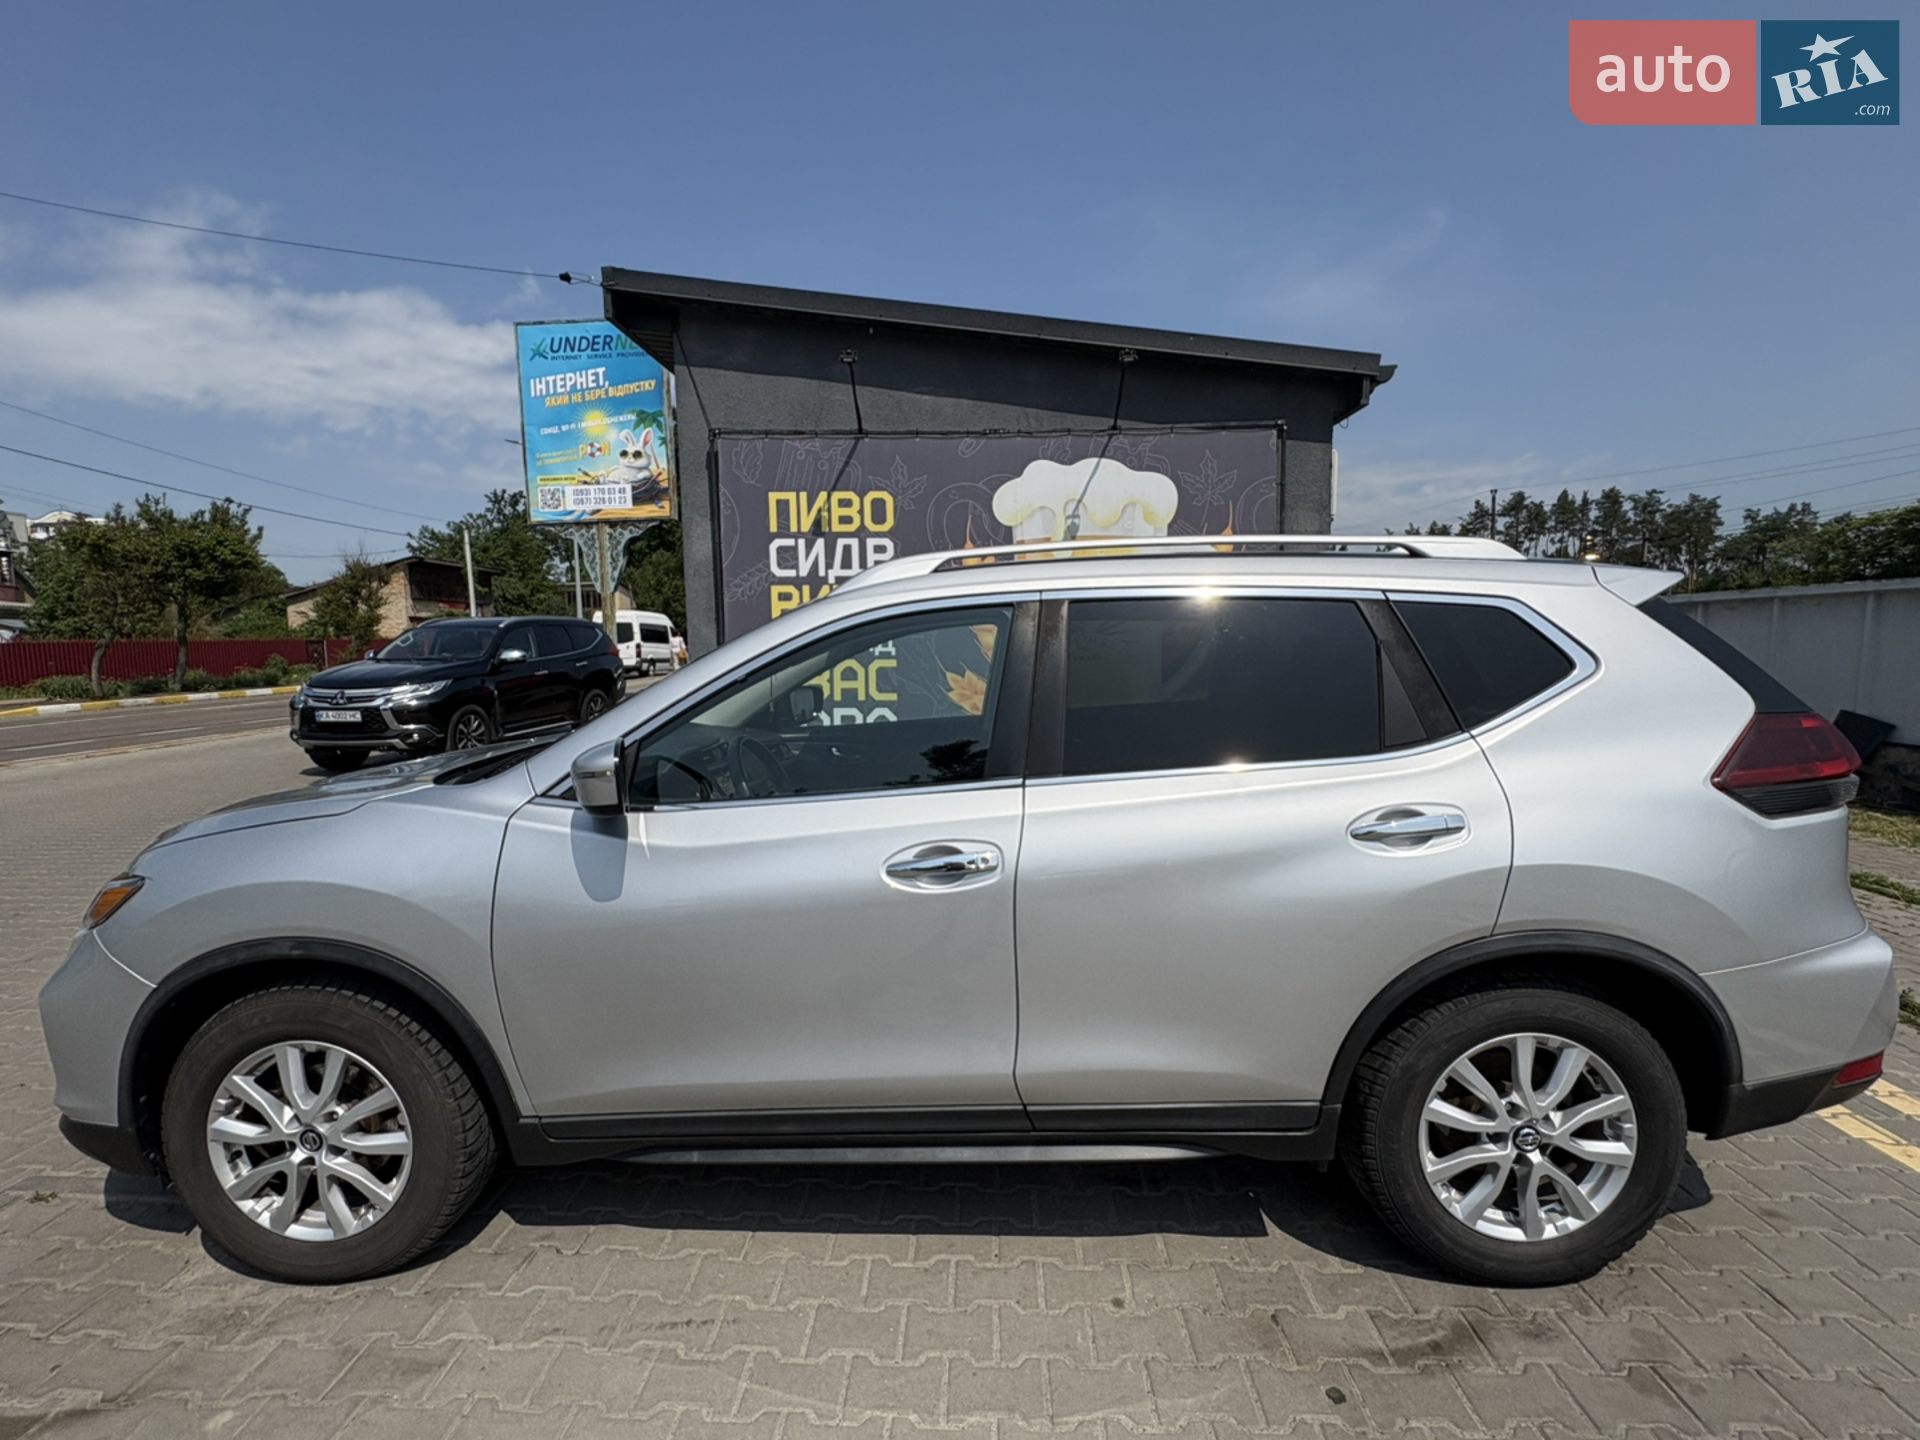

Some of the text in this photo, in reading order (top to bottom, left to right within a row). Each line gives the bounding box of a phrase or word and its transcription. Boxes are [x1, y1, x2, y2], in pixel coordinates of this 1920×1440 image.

[572, 391, 583, 404] НЕ
[585, 388, 607, 402] БЕРЕ
[608, 378, 657, 398] ВІДПУСТКУ
[593, 487, 606, 496] 170
[618, 496, 627, 504] 23
[768, 490, 895, 533] ПИВО
[768, 537, 895, 584] СИДР
